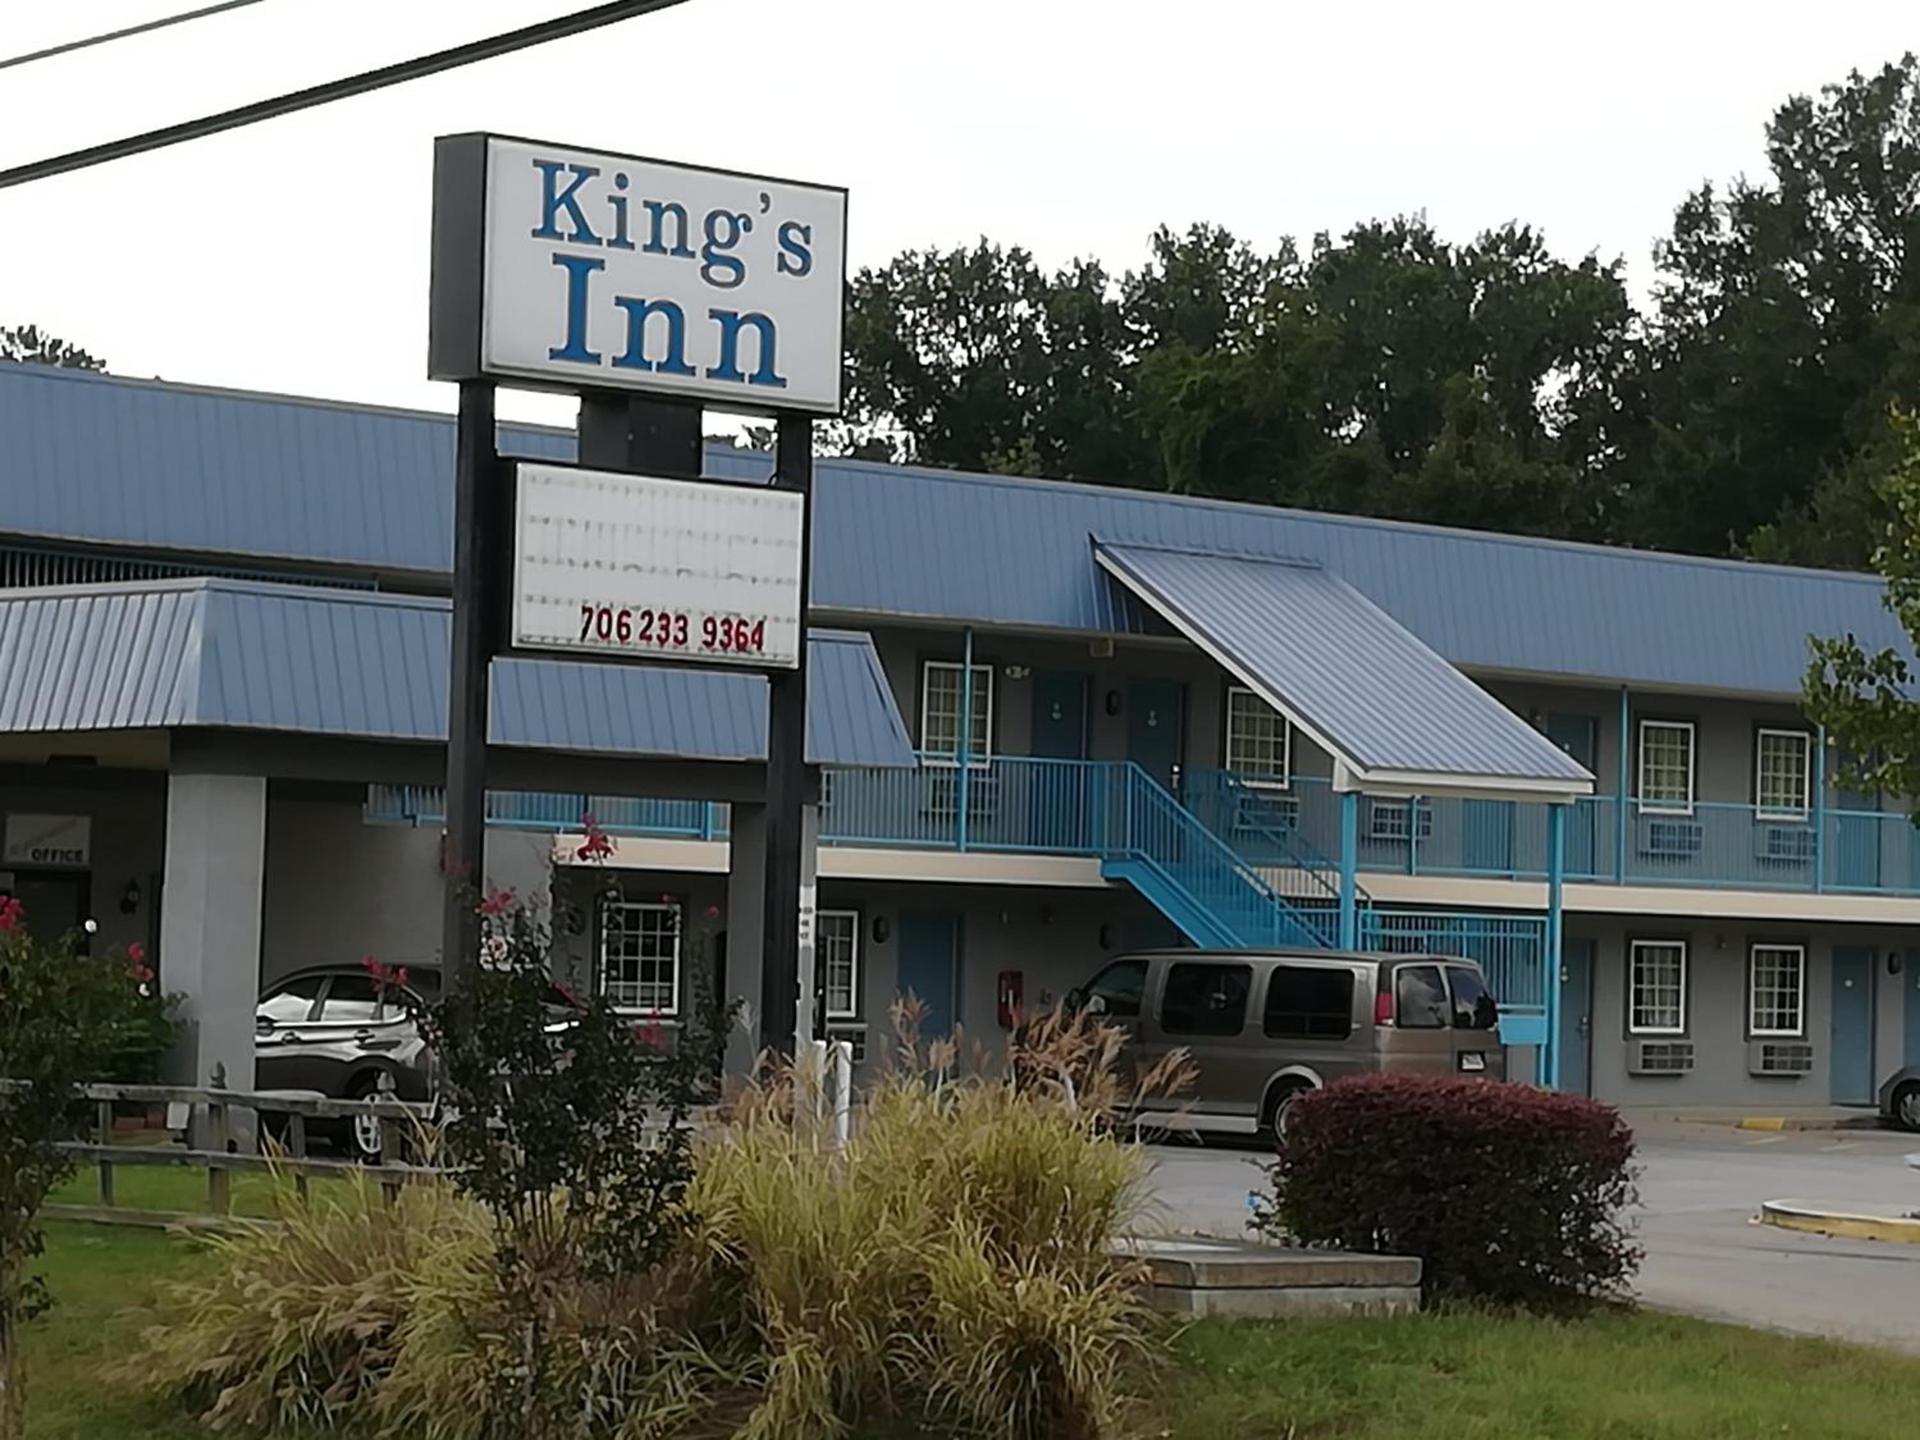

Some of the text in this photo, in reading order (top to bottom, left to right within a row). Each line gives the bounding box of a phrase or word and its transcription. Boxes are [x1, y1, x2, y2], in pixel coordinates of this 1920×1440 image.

[532, 159, 812, 288] King's
[549, 253, 787, 388] Inn
[580, 605, 765, 651] 706 233 9364
[31, 848, 83, 862] OFFICE
